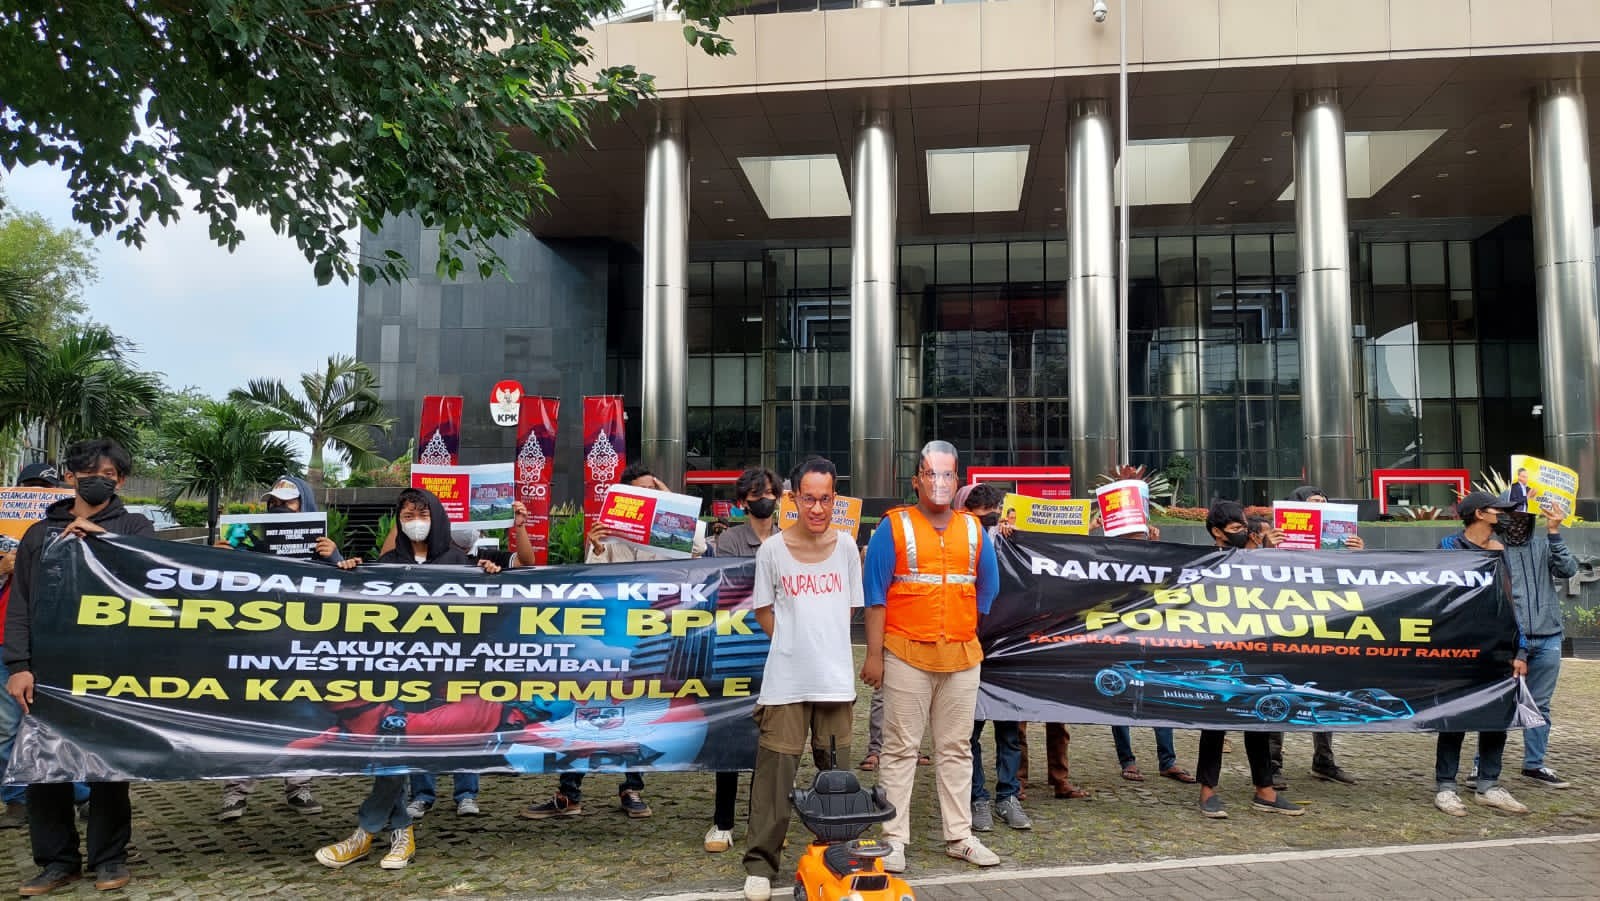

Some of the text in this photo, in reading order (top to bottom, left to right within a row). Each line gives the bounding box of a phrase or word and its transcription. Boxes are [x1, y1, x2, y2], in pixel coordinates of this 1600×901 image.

[497, 414, 518, 422] KPK
[520, 486, 546, 497] G20
[594, 484, 610, 494] G2
[1031, 556, 1494, 587] RAKYAT BUTUH MAKAN
[145, 568, 708, 602] SUDAH SAATNYA KPK
[1153, 584, 1365, 611] BUKAN
[77, 595, 754, 637] BERSURAT KE BPK
[1085, 608, 1433, 642] FORMULA E
[290, 640, 576, 658] LAKUKAN AUDIT
[1028, 633, 1481, 659] TANGKAP TUYUL YANG RAMPOK DUIT RAKYAT
[228, 655, 630, 673] INVESTIGATIF KEMBALI
[71, 674, 752, 703] PADA KASUS FORMULA E
[1163, 689, 1194, 700] Julius
